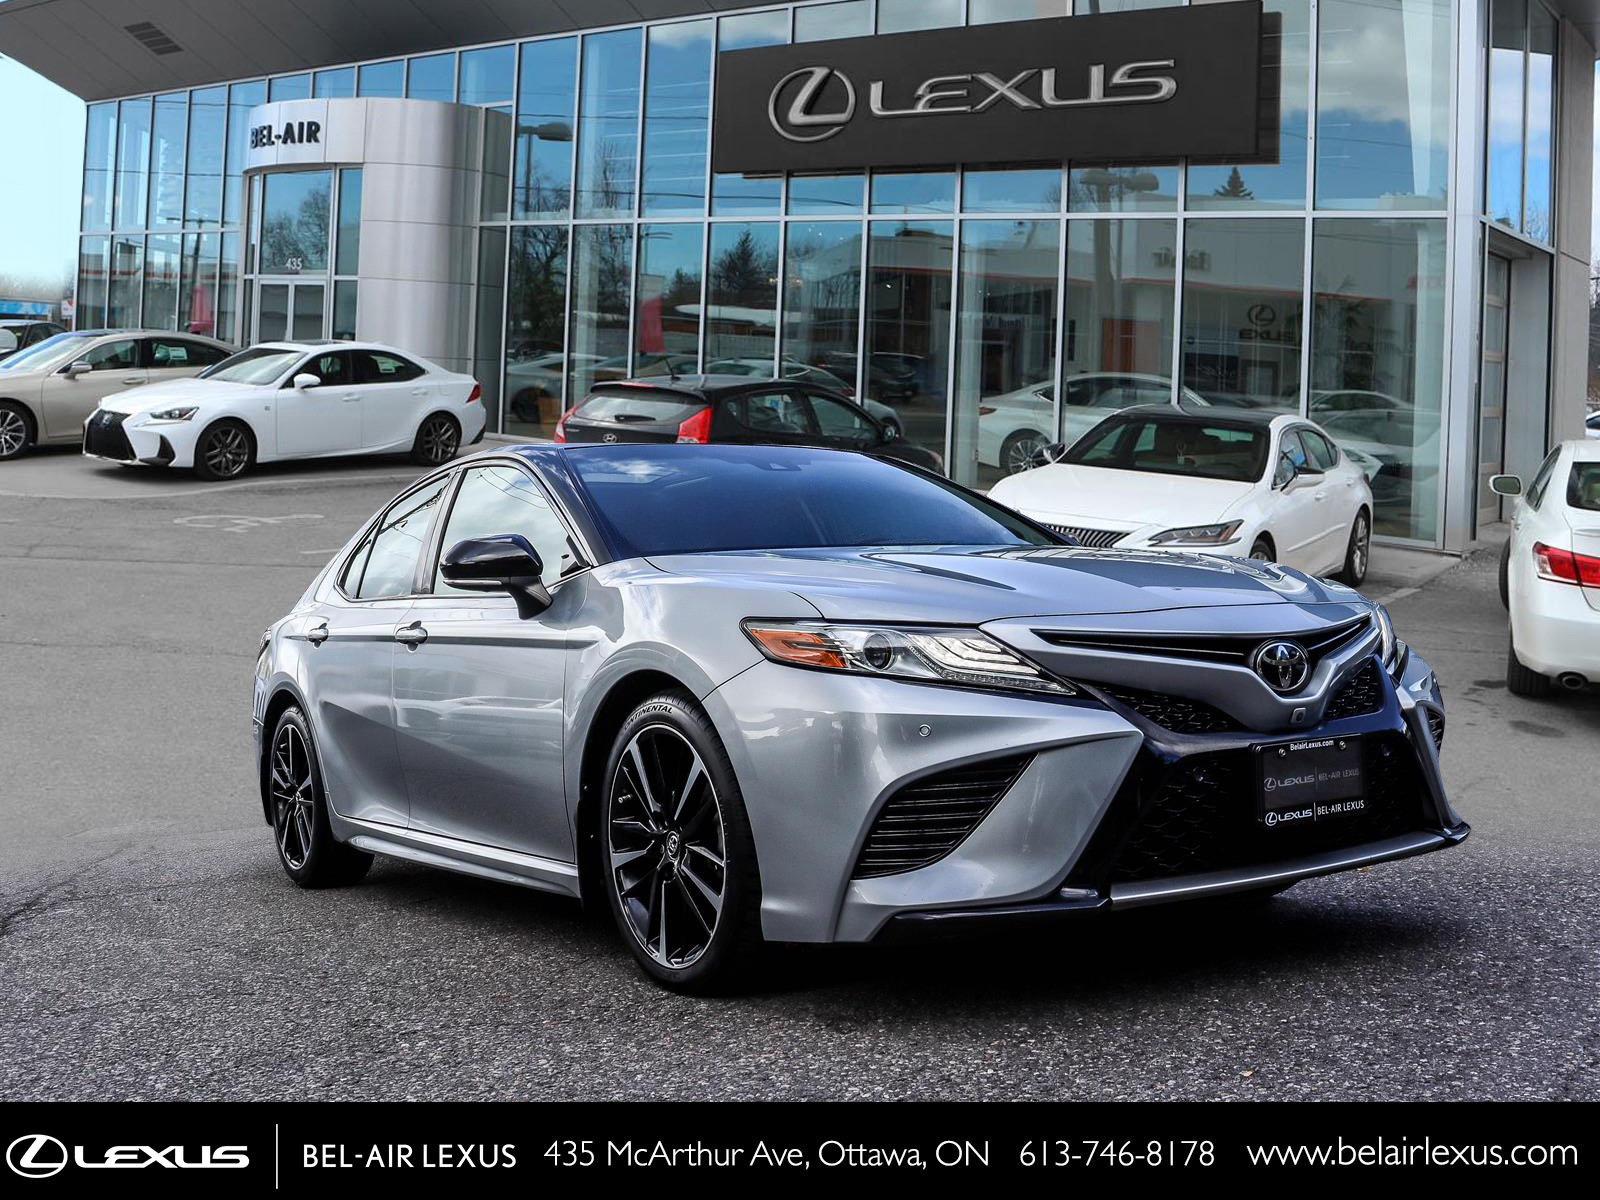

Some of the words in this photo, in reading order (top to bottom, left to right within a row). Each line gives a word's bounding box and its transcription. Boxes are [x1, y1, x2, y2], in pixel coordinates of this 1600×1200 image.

[869, 59, 1178, 119] LEXUS
[250, 121, 321, 149] BEL-AIR
[286, 257, 303, 270] 435
[1290, 740, 1335, 751] BelairLexus.com
[1278, 775, 1315, 787] LEXUS
[1278, 809, 1313, 822] LEXUS
[1317, 803, 1342, 816] BEL-AIR
[1343, 800, 1365, 812] LEXUS
